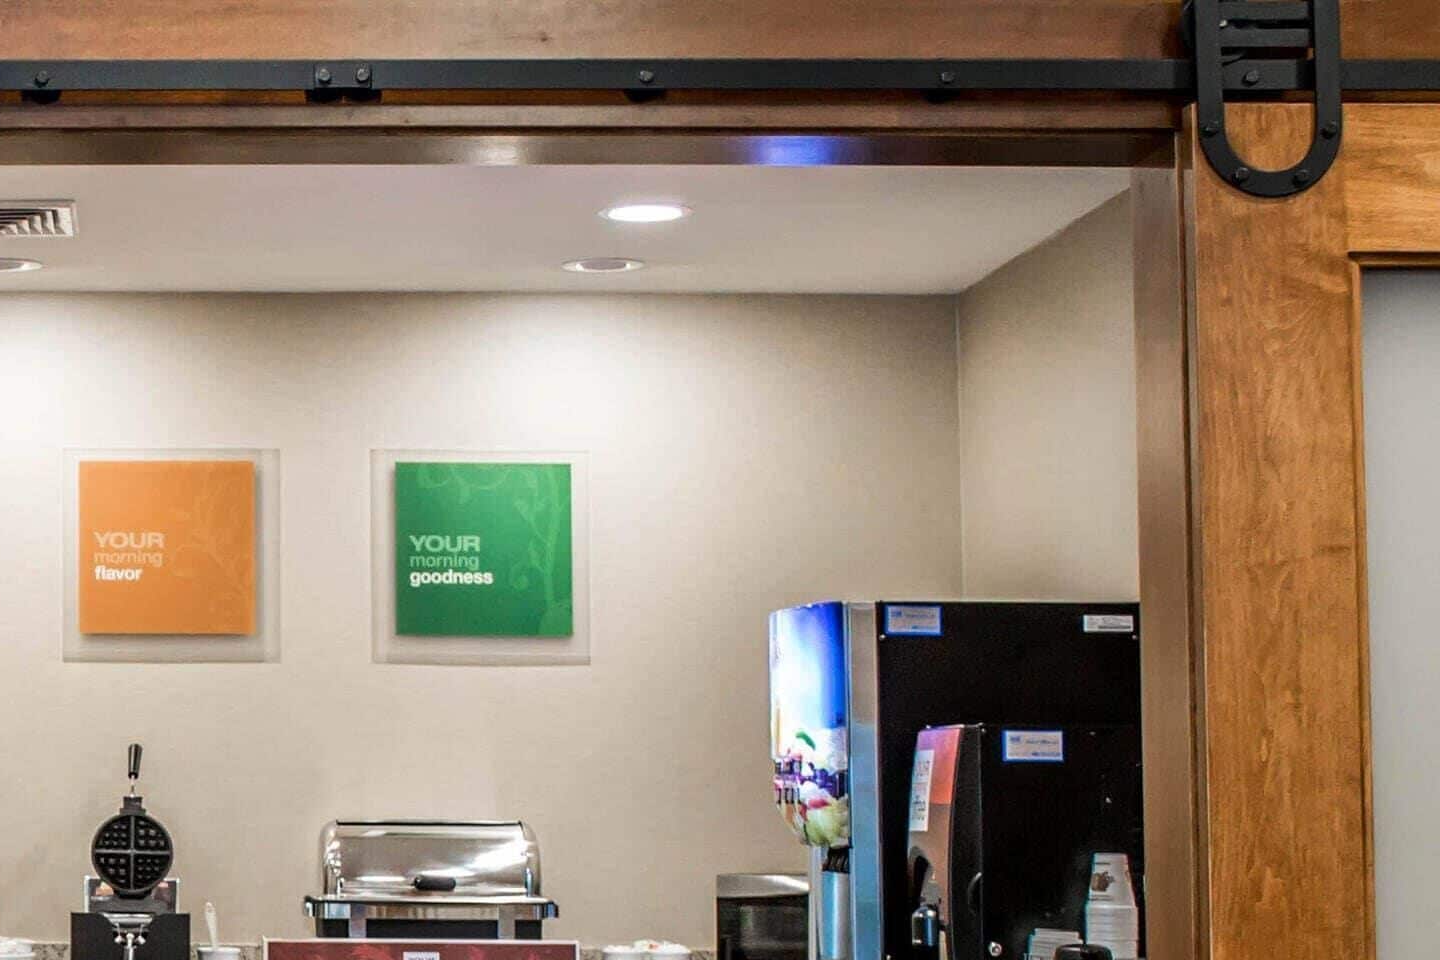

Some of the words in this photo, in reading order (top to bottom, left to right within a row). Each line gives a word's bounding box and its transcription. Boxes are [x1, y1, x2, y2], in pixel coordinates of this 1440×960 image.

[94, 531, 164, 549] YOUR
[409, 535, 481, 553] YOUR
[94, 550, 163, 568] morning
[409, 553, 479, 571] morning
[94, 565, 143, 581] flavor
[409, 570, 494, 587] goodness
